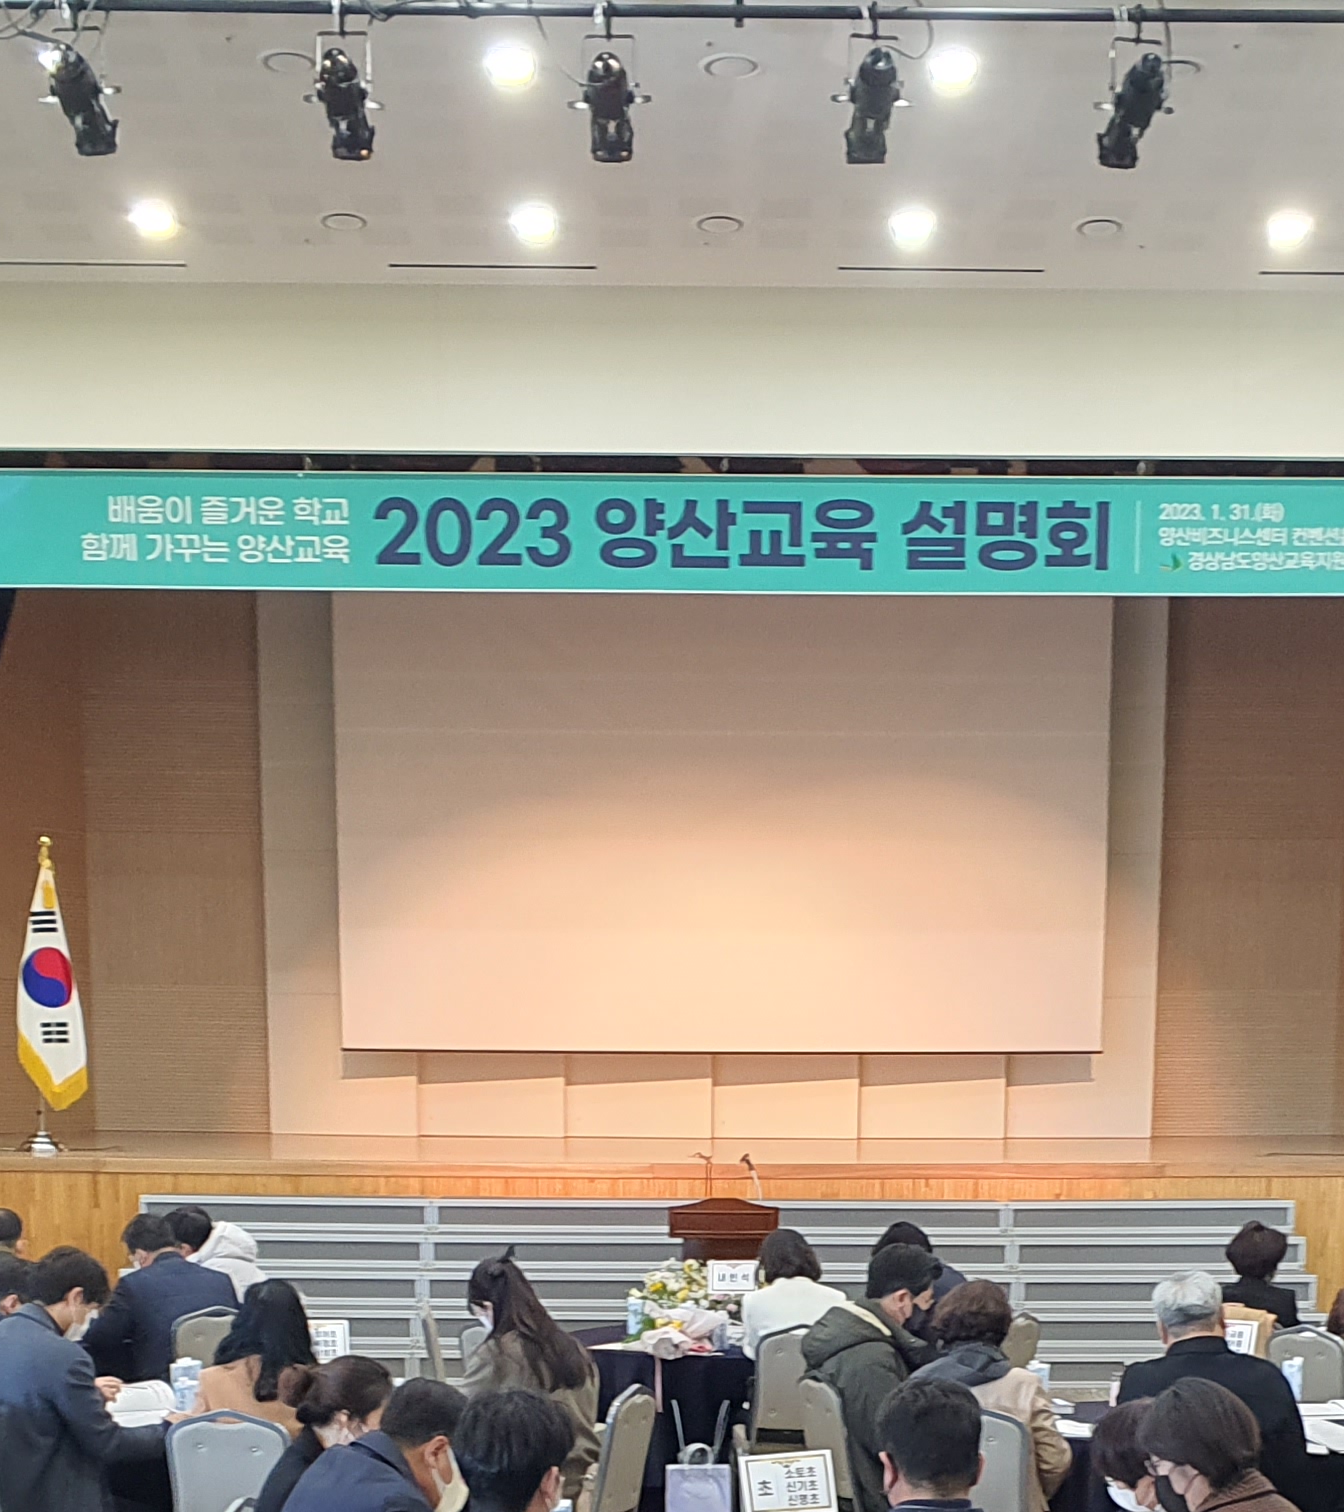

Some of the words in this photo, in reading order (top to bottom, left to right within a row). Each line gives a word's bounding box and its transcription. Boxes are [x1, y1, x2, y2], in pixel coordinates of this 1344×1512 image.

[107, 495, 193, 525] 배움이
[200, 496, 286, 526] 즐거운
[292, 496, 350, 526] 학교
[1158, 502, 1206, 521] 2023.
[372, 496, 574, 569] 2023
[594, 497, 879, 571] 양산교육
[900, 499, 1109, 573] 설명회
[1158, 526, 1288, 547] 양산비즈니스센터
[80, 533, 139, 562] 함께
[145, 533, 231, 563] 가꾸는
[236, 534, 351, 564] 양산교육
[784, 1466, 818, 1480] 소토초
[757, 1479, 775, 1497] 초
[786, 1479, 820, 1493] 신기초
